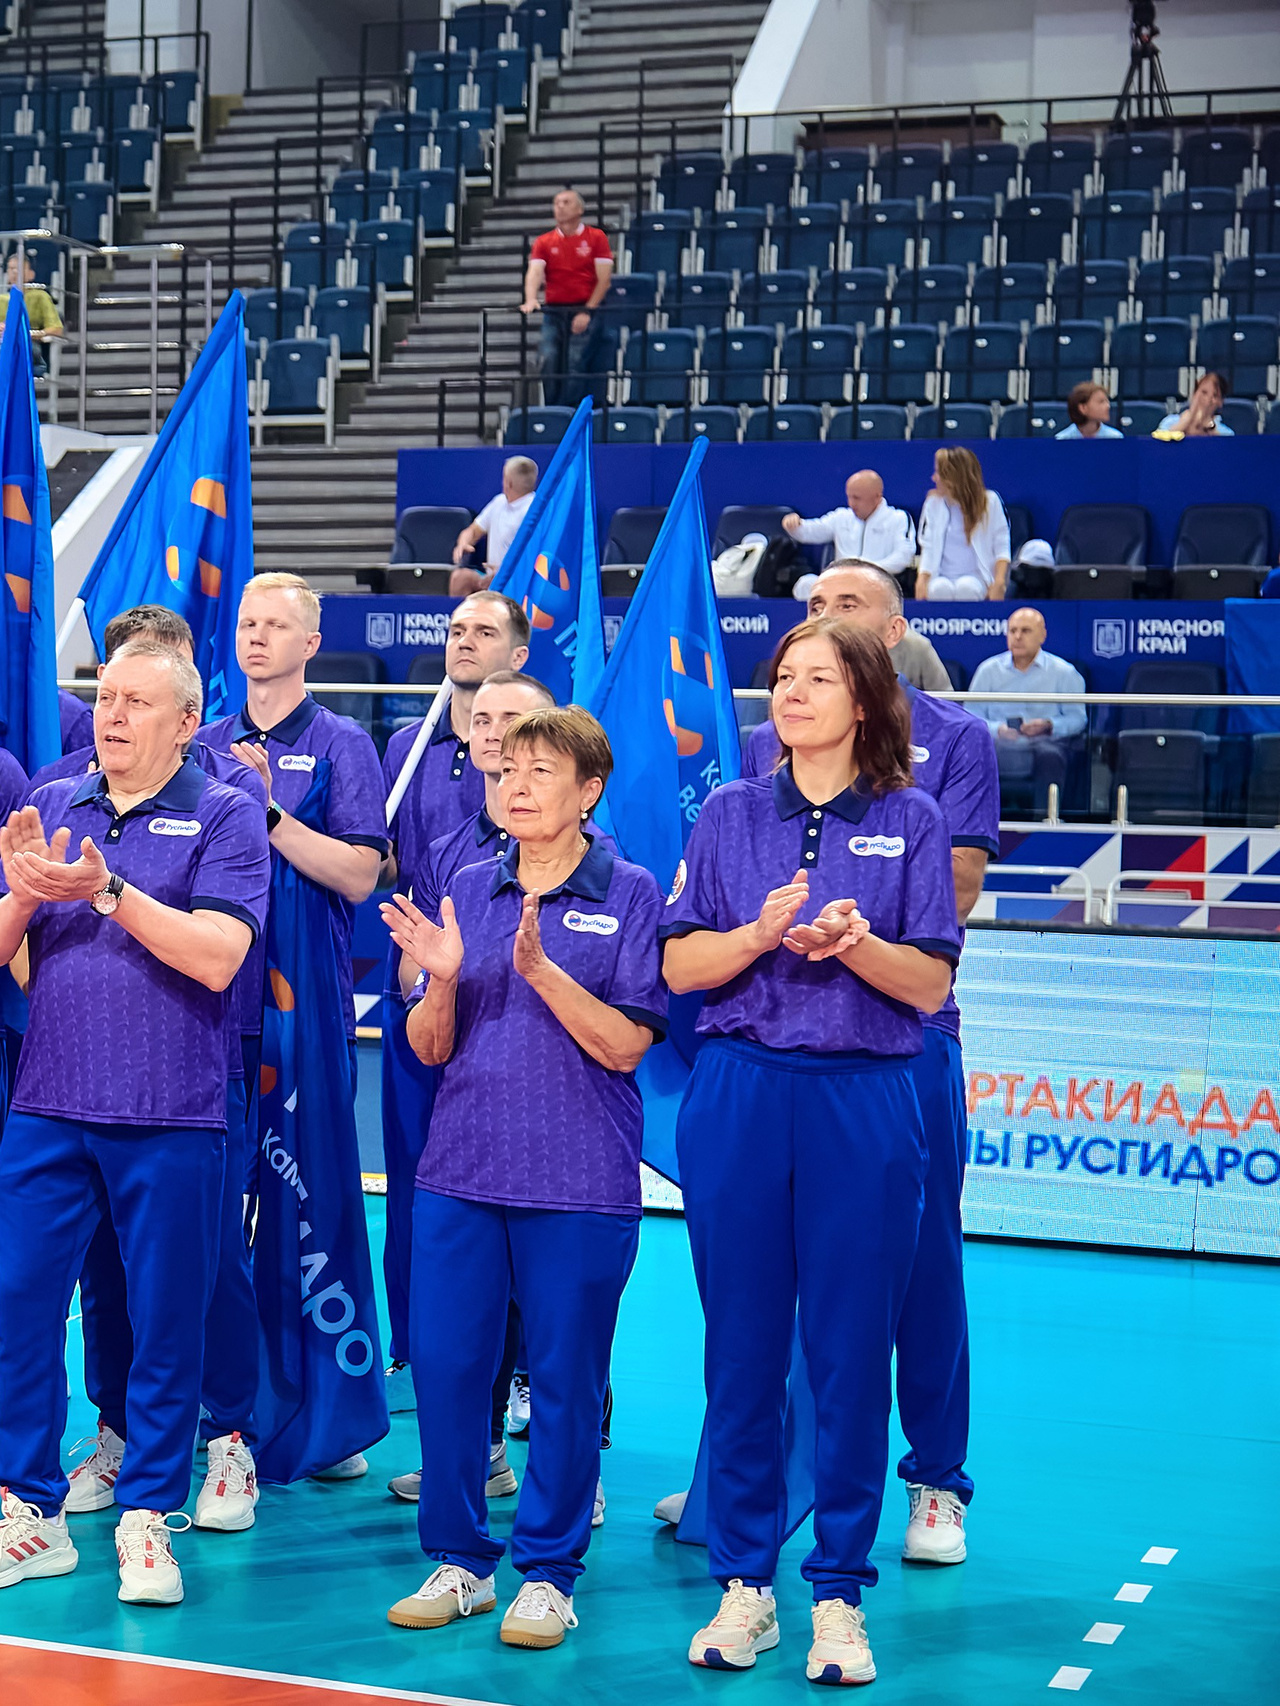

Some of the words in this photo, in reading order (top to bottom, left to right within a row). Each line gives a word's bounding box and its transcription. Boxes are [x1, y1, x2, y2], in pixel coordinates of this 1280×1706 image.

[721, 614, 770, 633] СКИЙ
[1138, 635, 1187, 654] КРАЙ
[1024, 1134, 1280, 1188] РУСГИДРО
